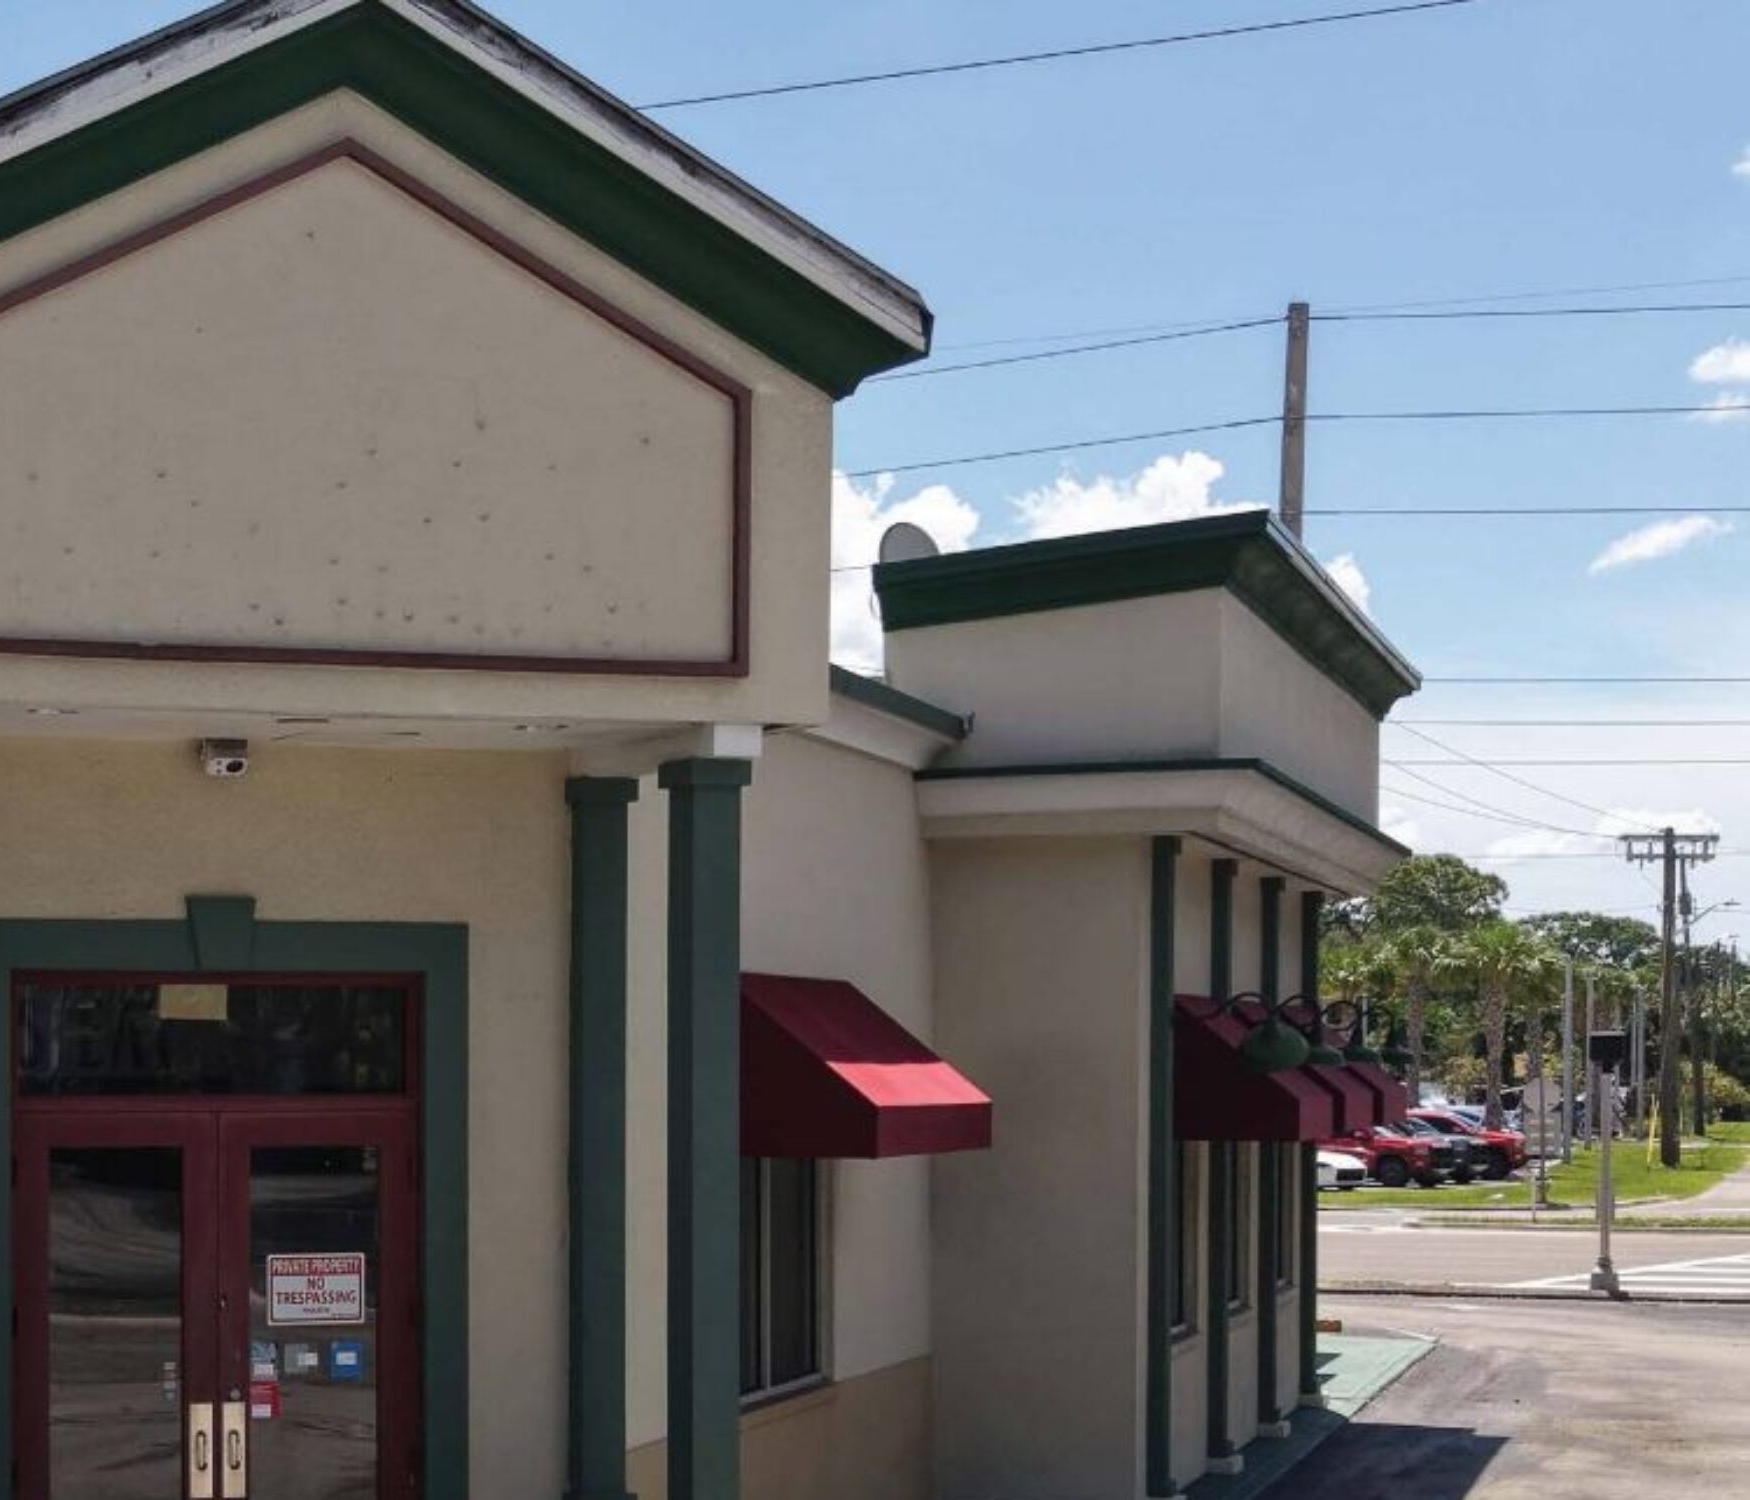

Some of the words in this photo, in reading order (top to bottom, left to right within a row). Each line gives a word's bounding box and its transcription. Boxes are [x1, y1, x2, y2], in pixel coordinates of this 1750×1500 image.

[272, 1259, 309, 1274] PRIVATE
[311, 1258, 360, 1273] PROPERTY
[307, 1278, 325, 1290] NO
[277, 1290, 357, 1305] TRESPASSING
